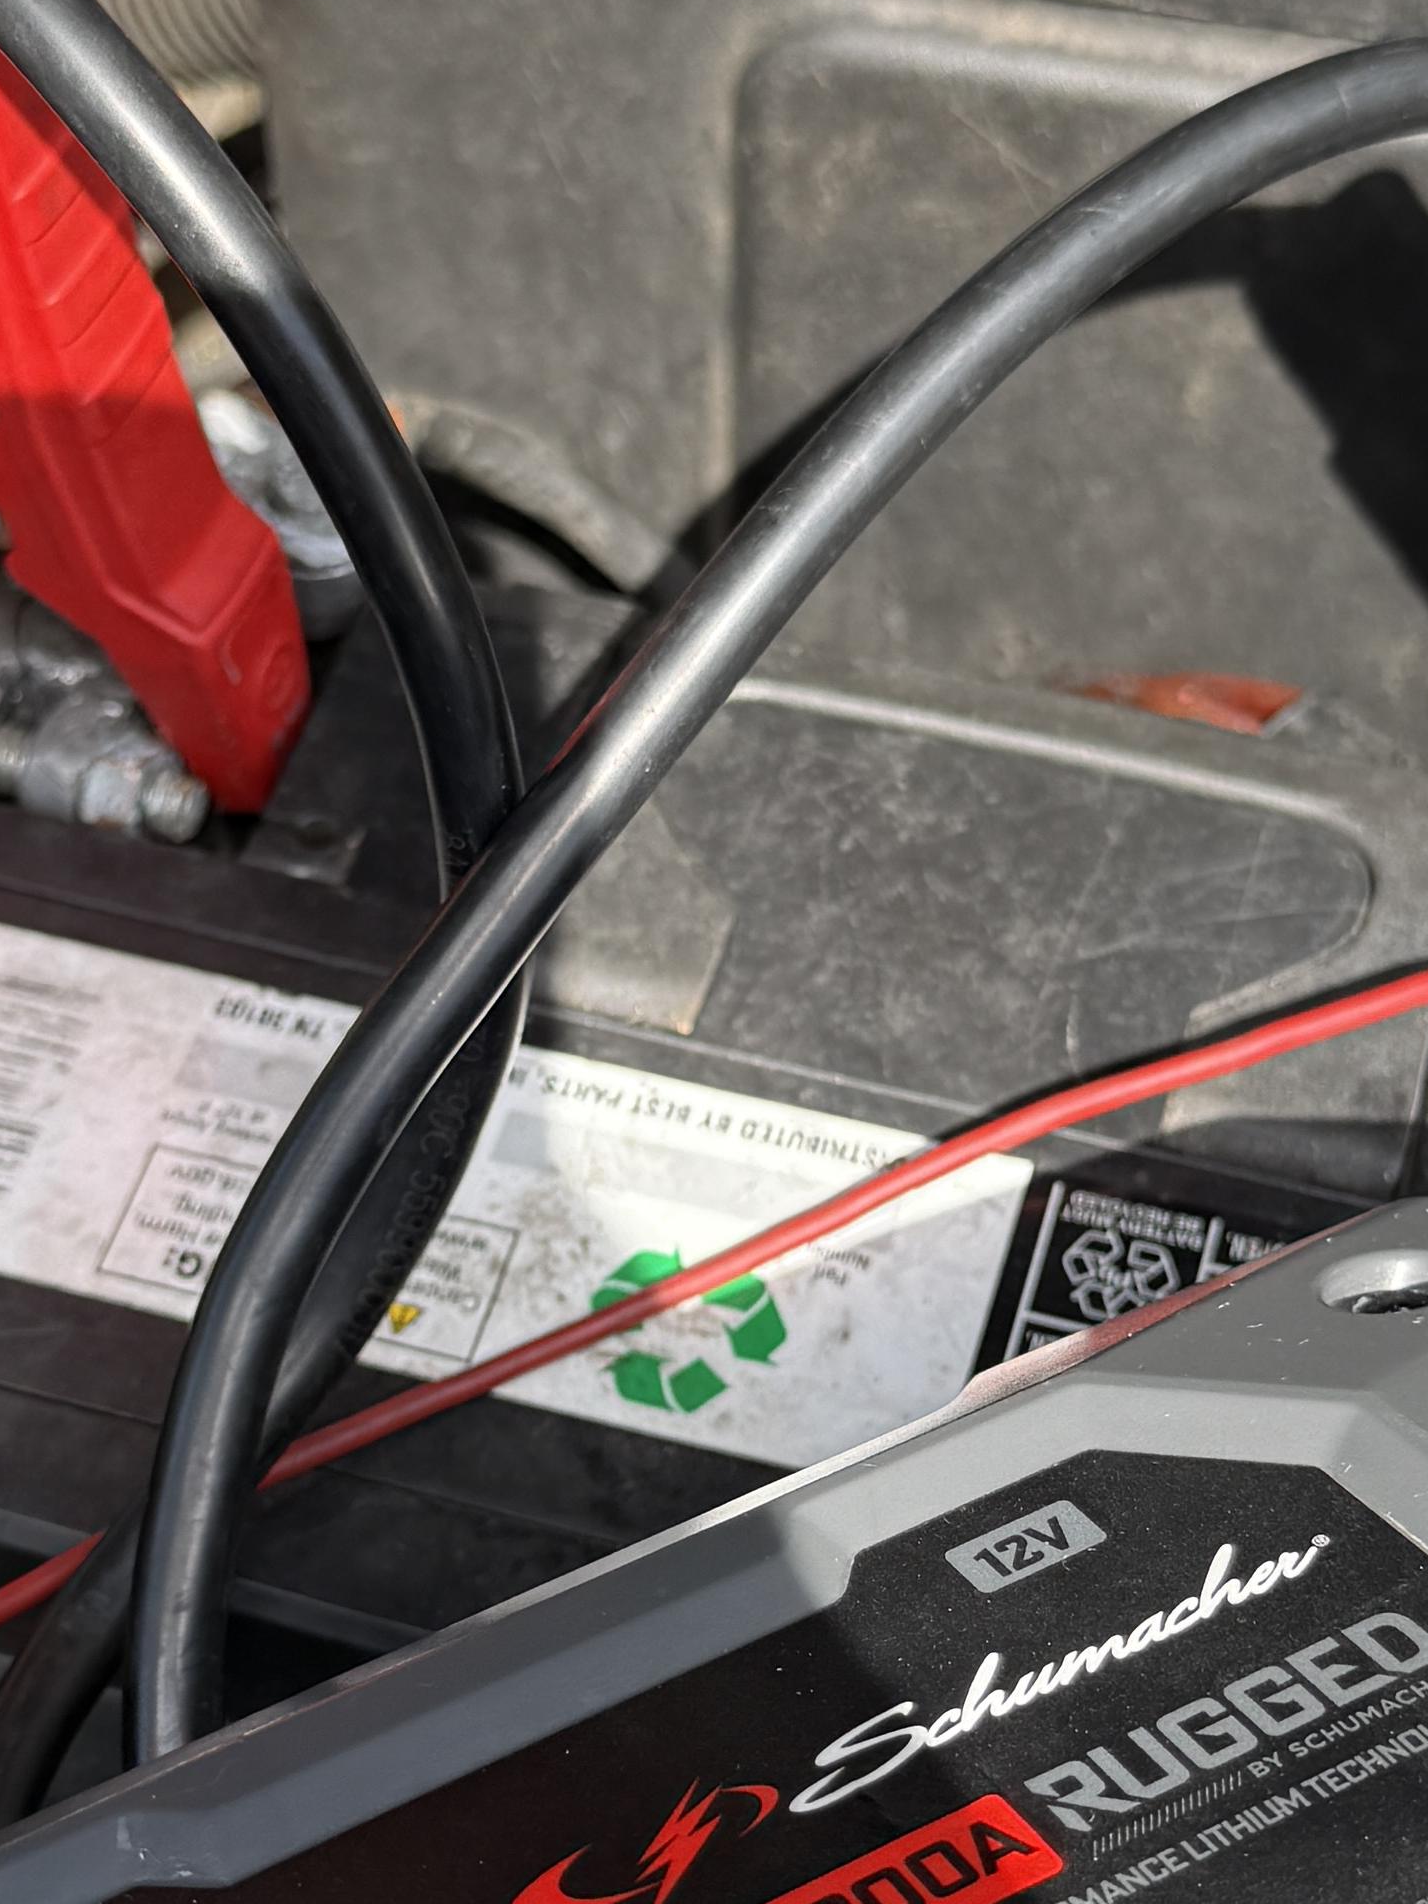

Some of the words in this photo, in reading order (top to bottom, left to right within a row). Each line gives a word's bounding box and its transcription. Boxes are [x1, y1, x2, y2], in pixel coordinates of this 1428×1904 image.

[972, 1516, 1070, 1579] 12V
[1247, 1751, 1284, 1778] BY
[1179, 1786, 1312, 1862] LITHIUM
